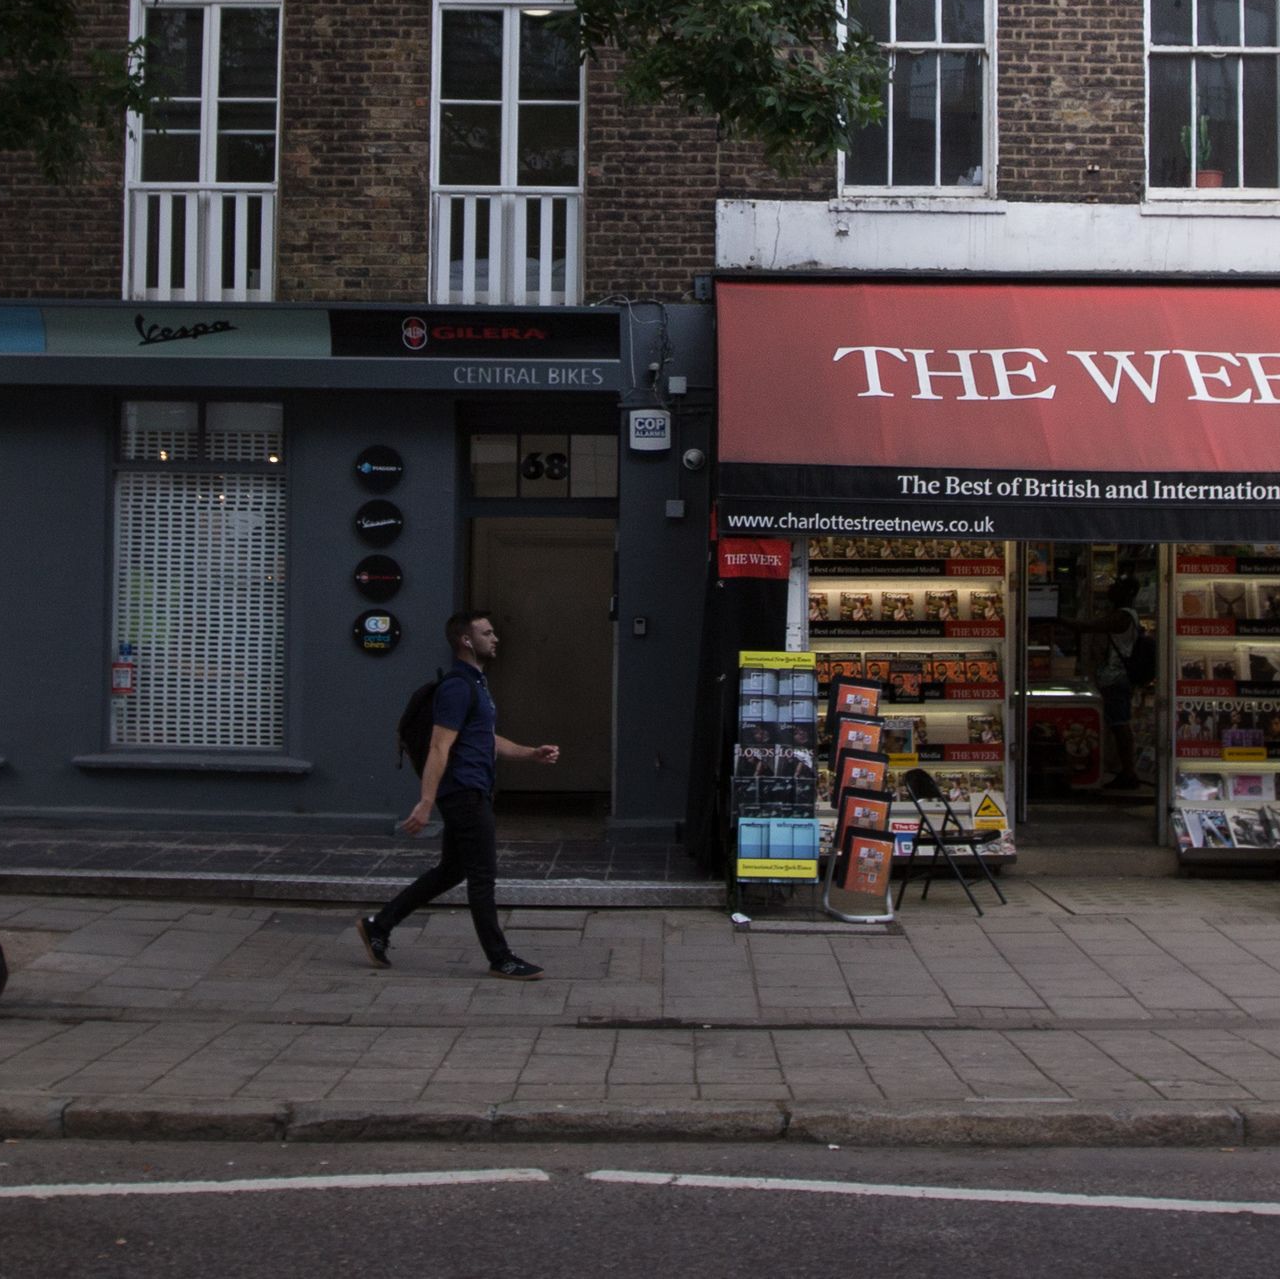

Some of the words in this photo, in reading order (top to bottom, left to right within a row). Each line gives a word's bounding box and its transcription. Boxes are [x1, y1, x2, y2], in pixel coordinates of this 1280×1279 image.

[135, 314, 239, 345] Vespa
[431, 326, 546, 340] GILERA
[453, 367, 541, 384] CENTRAL
[547, 368, 604, 385] BIKES
[833, 346, 1056, 400] THE
[634, 418, 666, 431] COP
[634, 430, 666, 438] ALARMS
[521, 452, 569, 481] 68
[898, 475, 940, 495] The
[945, 476, 992, 496] Best
[997, 477, 1020, 496] of
[1024, 477, 1101, 498] British
[1105, 480, 1147, 500] and
[728, 512, 995, 533] www.charlottestreetnews.co.uk
[725, 553, 748, 566] THE
[750, 553, 782, 567] WEEK
[1217, 701, 1253, 712] LOVE
[951, 751, 970, 760] THE
[972, 751, 1000, 760] WEEK
